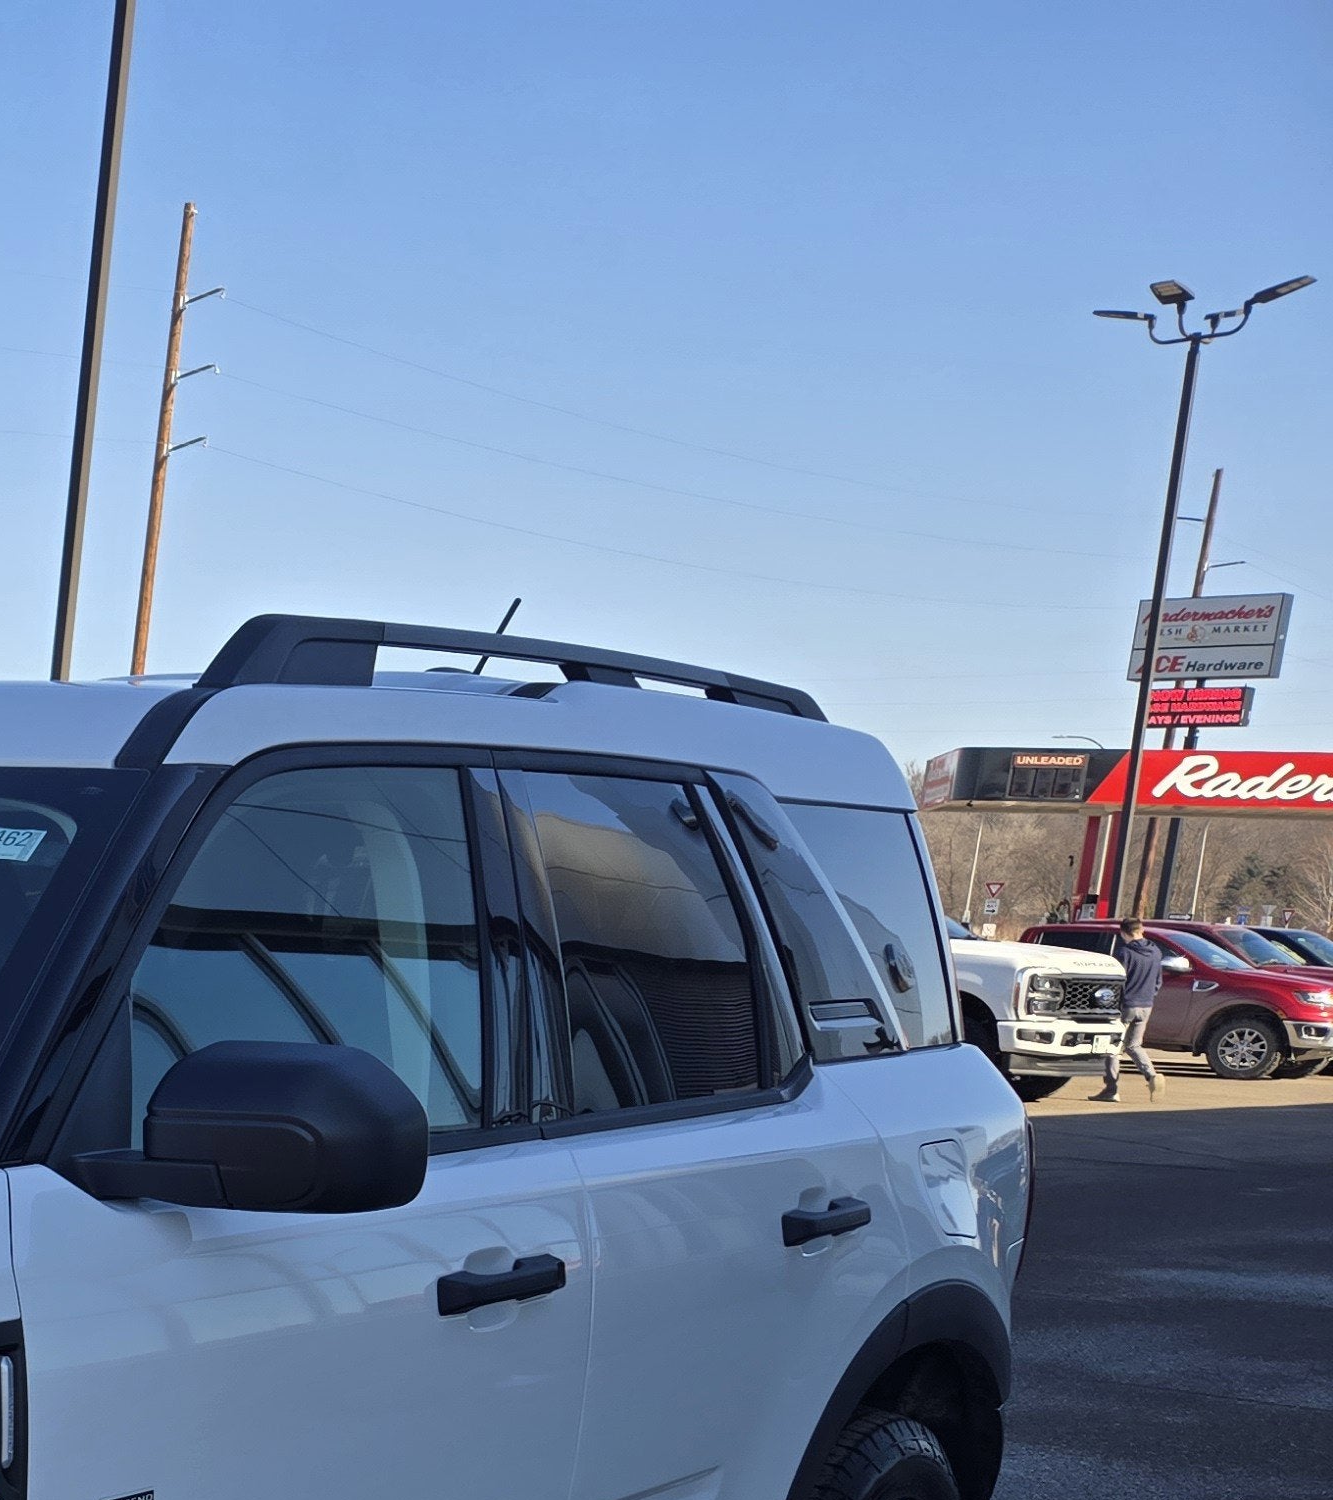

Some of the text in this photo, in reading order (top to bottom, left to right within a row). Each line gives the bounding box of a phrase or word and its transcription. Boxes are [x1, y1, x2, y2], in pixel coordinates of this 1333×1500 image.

[1211, 624, 1269, 634] MARKET
[1136, 655, 1264, 674] CE Hardware
[1148, 715, 1172, 725] AYS
[1180, 714, 1241, 724] EVENINGS
[1016, 756, 1083, 766] UNLEADED
